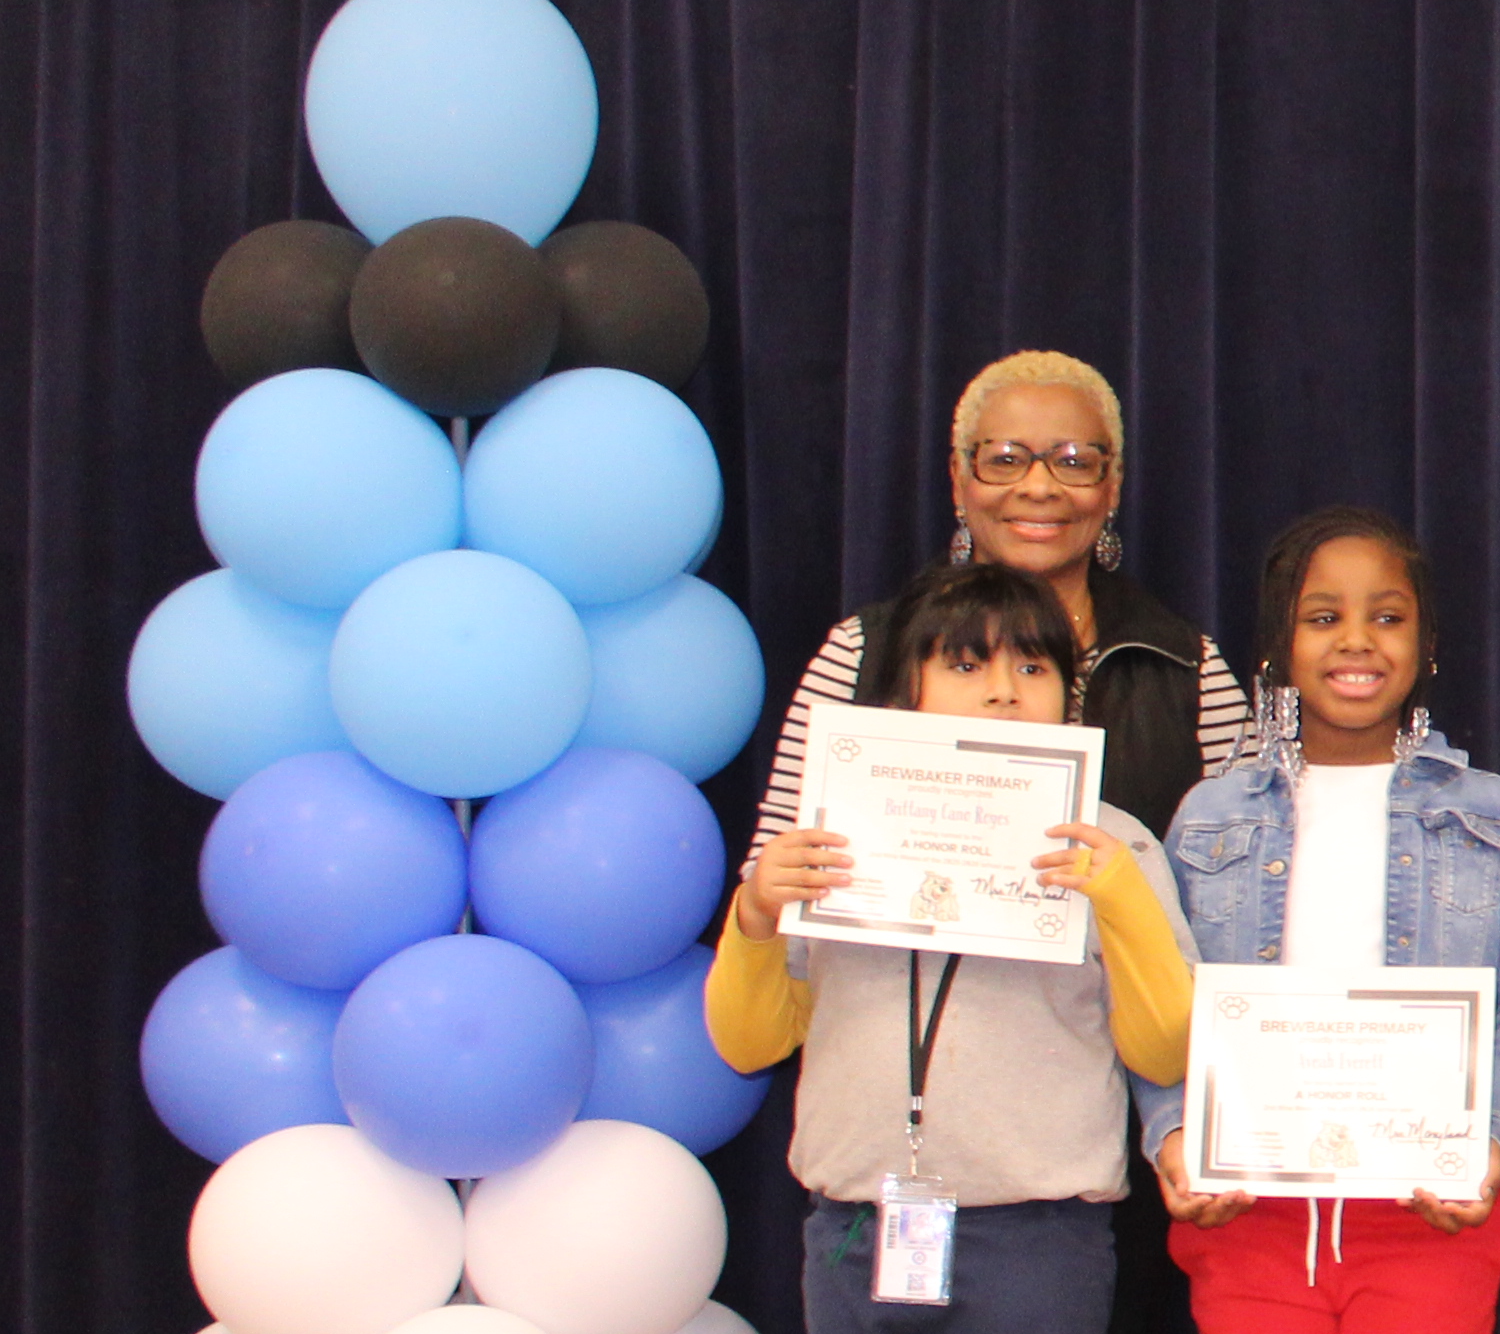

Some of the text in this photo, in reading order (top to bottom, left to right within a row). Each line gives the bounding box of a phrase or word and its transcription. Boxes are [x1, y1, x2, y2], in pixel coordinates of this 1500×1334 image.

[871, 765, 1032, 791] BREWBAKER PRIMARY
[901, 839, 992, 856] A HONOR ROLL
[1260, 1020, 1426, 1034] BREWBAKER PRIMARY
[1295, 1091, 1387, 1101] A HONOR ROLL
